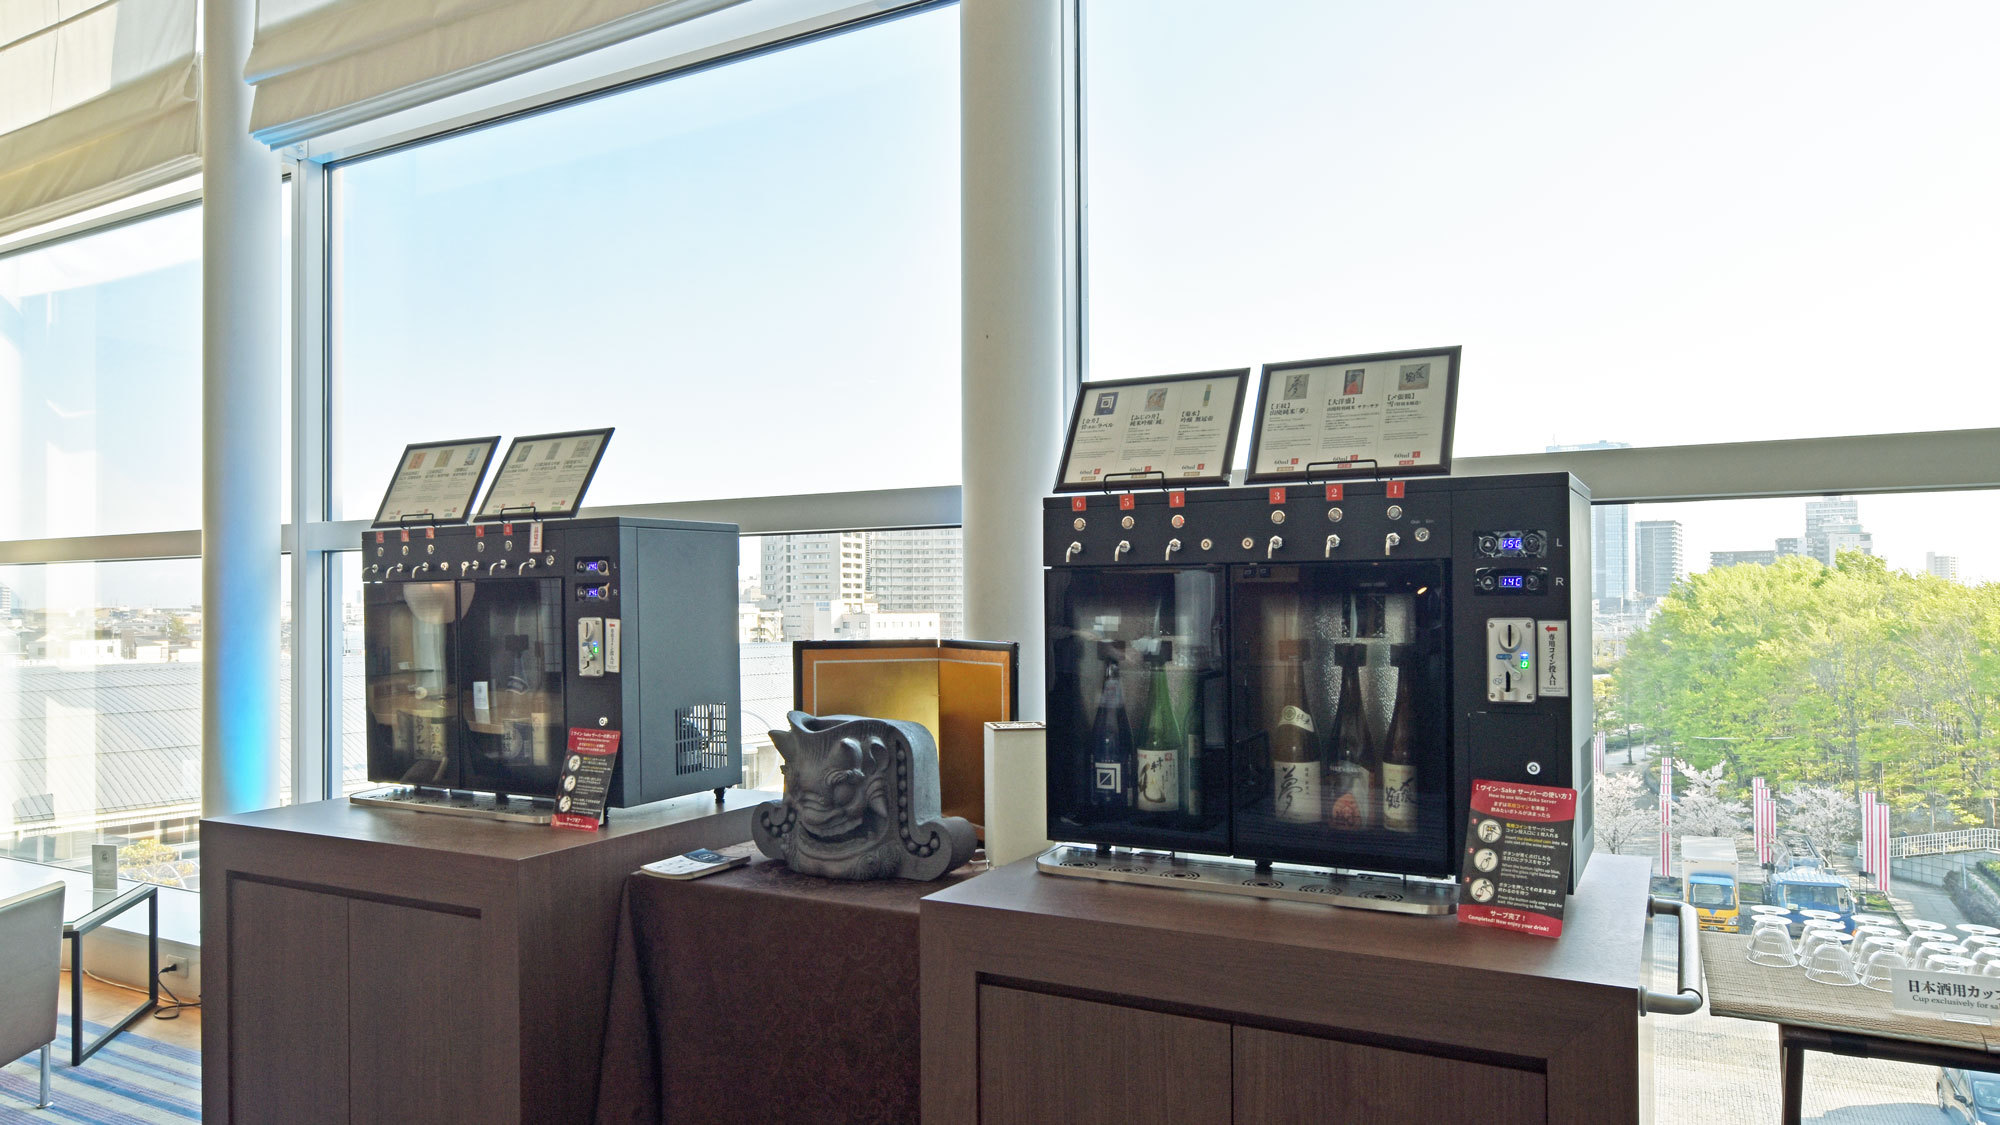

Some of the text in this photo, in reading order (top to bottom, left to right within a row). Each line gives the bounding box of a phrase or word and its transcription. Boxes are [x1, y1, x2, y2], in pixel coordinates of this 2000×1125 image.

[1274, 492, 1280, 500] 3
[1331, 489, 1337, 497] 2
[1556, 538, 1563, 547] L
[1555, 577, 1564, 586] R
[1548, 633, 1556, 686] 専用コイン投入口
[1468, 914, 1495, 923] Completed!
[1490, 910, 1526, 921] サーブ完了！
[1912, 994, 1930, 1004] Cup
[1931, 998, 1975, 1008] exclusively
[1976, 1001, 1988, 1009] for
